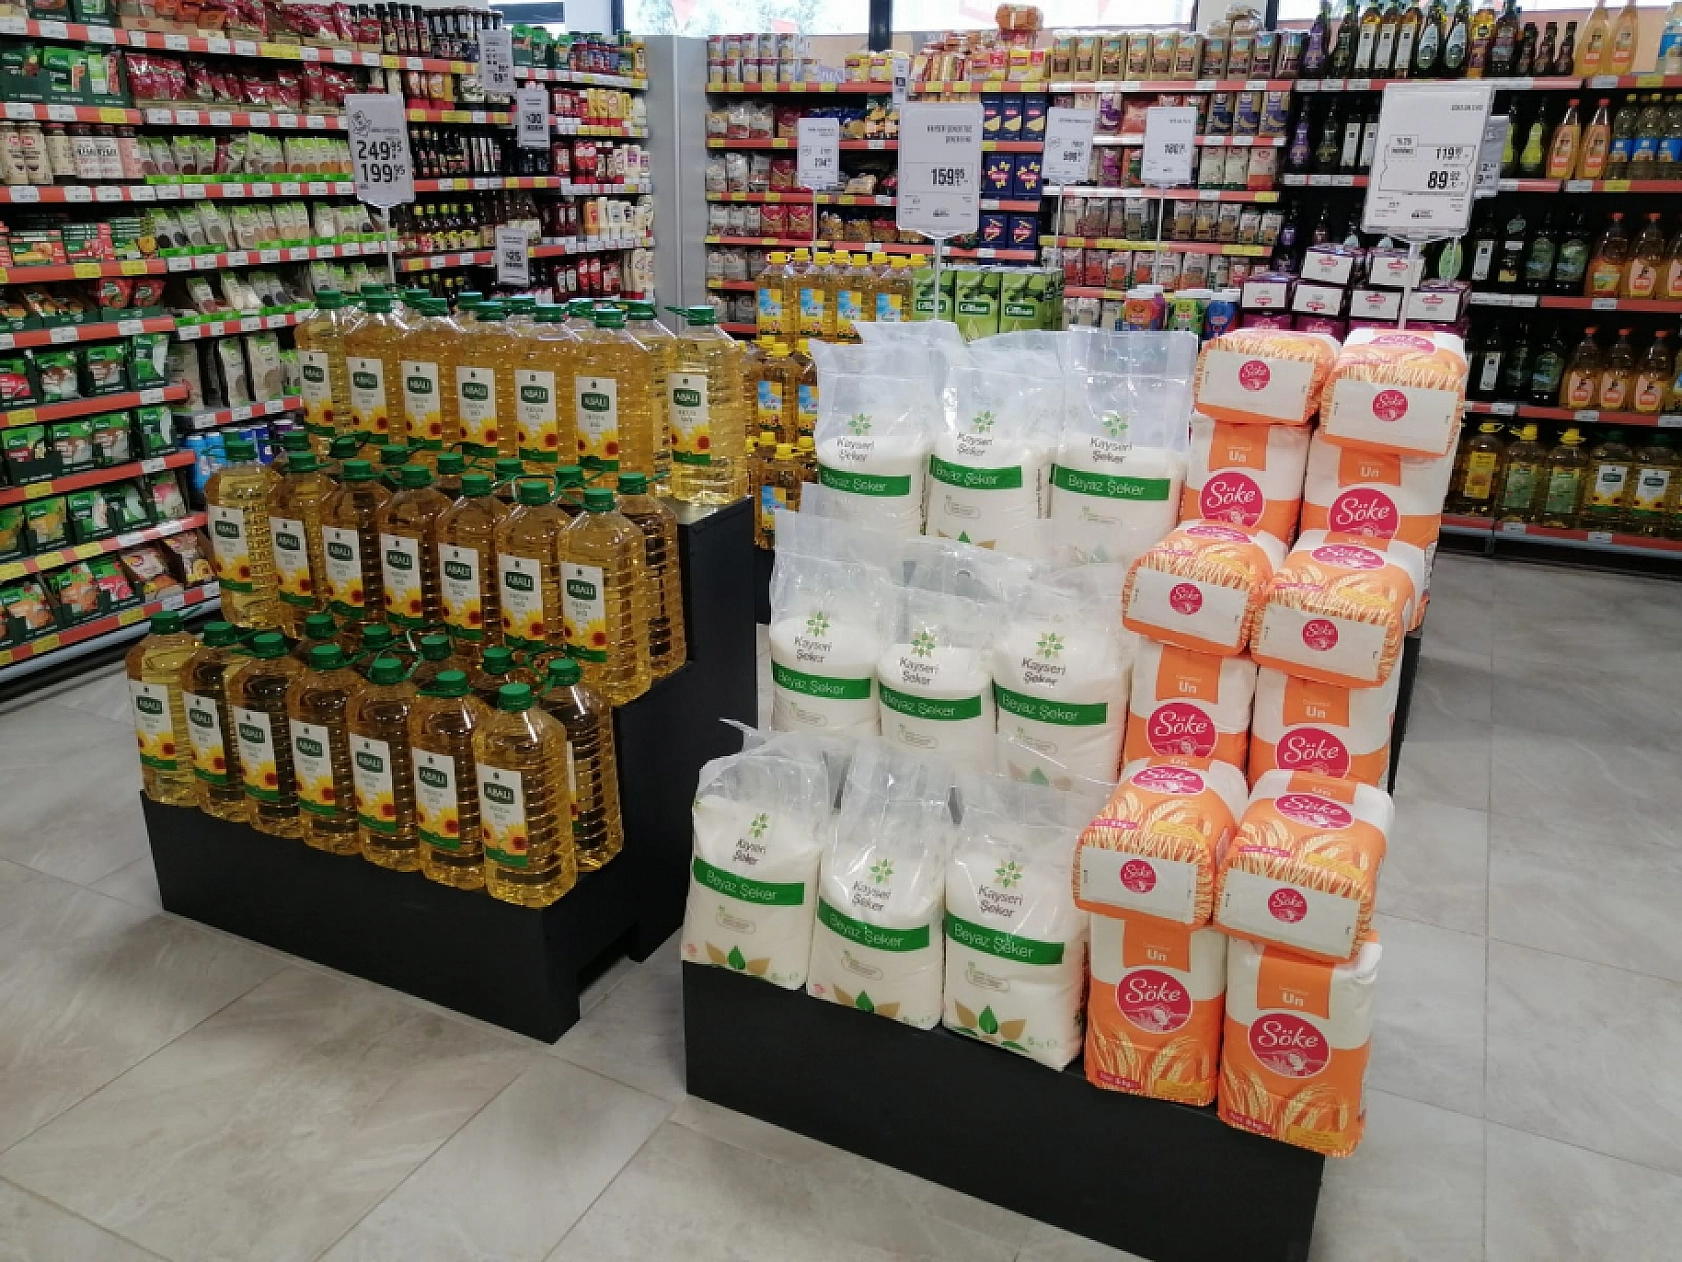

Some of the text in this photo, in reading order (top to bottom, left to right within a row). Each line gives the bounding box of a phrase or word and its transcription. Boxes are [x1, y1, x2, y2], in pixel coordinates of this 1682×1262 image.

[357, 140, 391, 160] 249
[360, 164, 393, 183] 199
[931, 167, 954, 187] 159
[1207, 482, 1256, 509] Söke
[1336, 498, 1390, 525] Söke
[1154, 711, 1208, 737] Söke
[1284, 735, 1339, 763] Söke
[1124, 978, 1182, 1004] Söke
[1258, 1021, 1319, 1048] Söke
